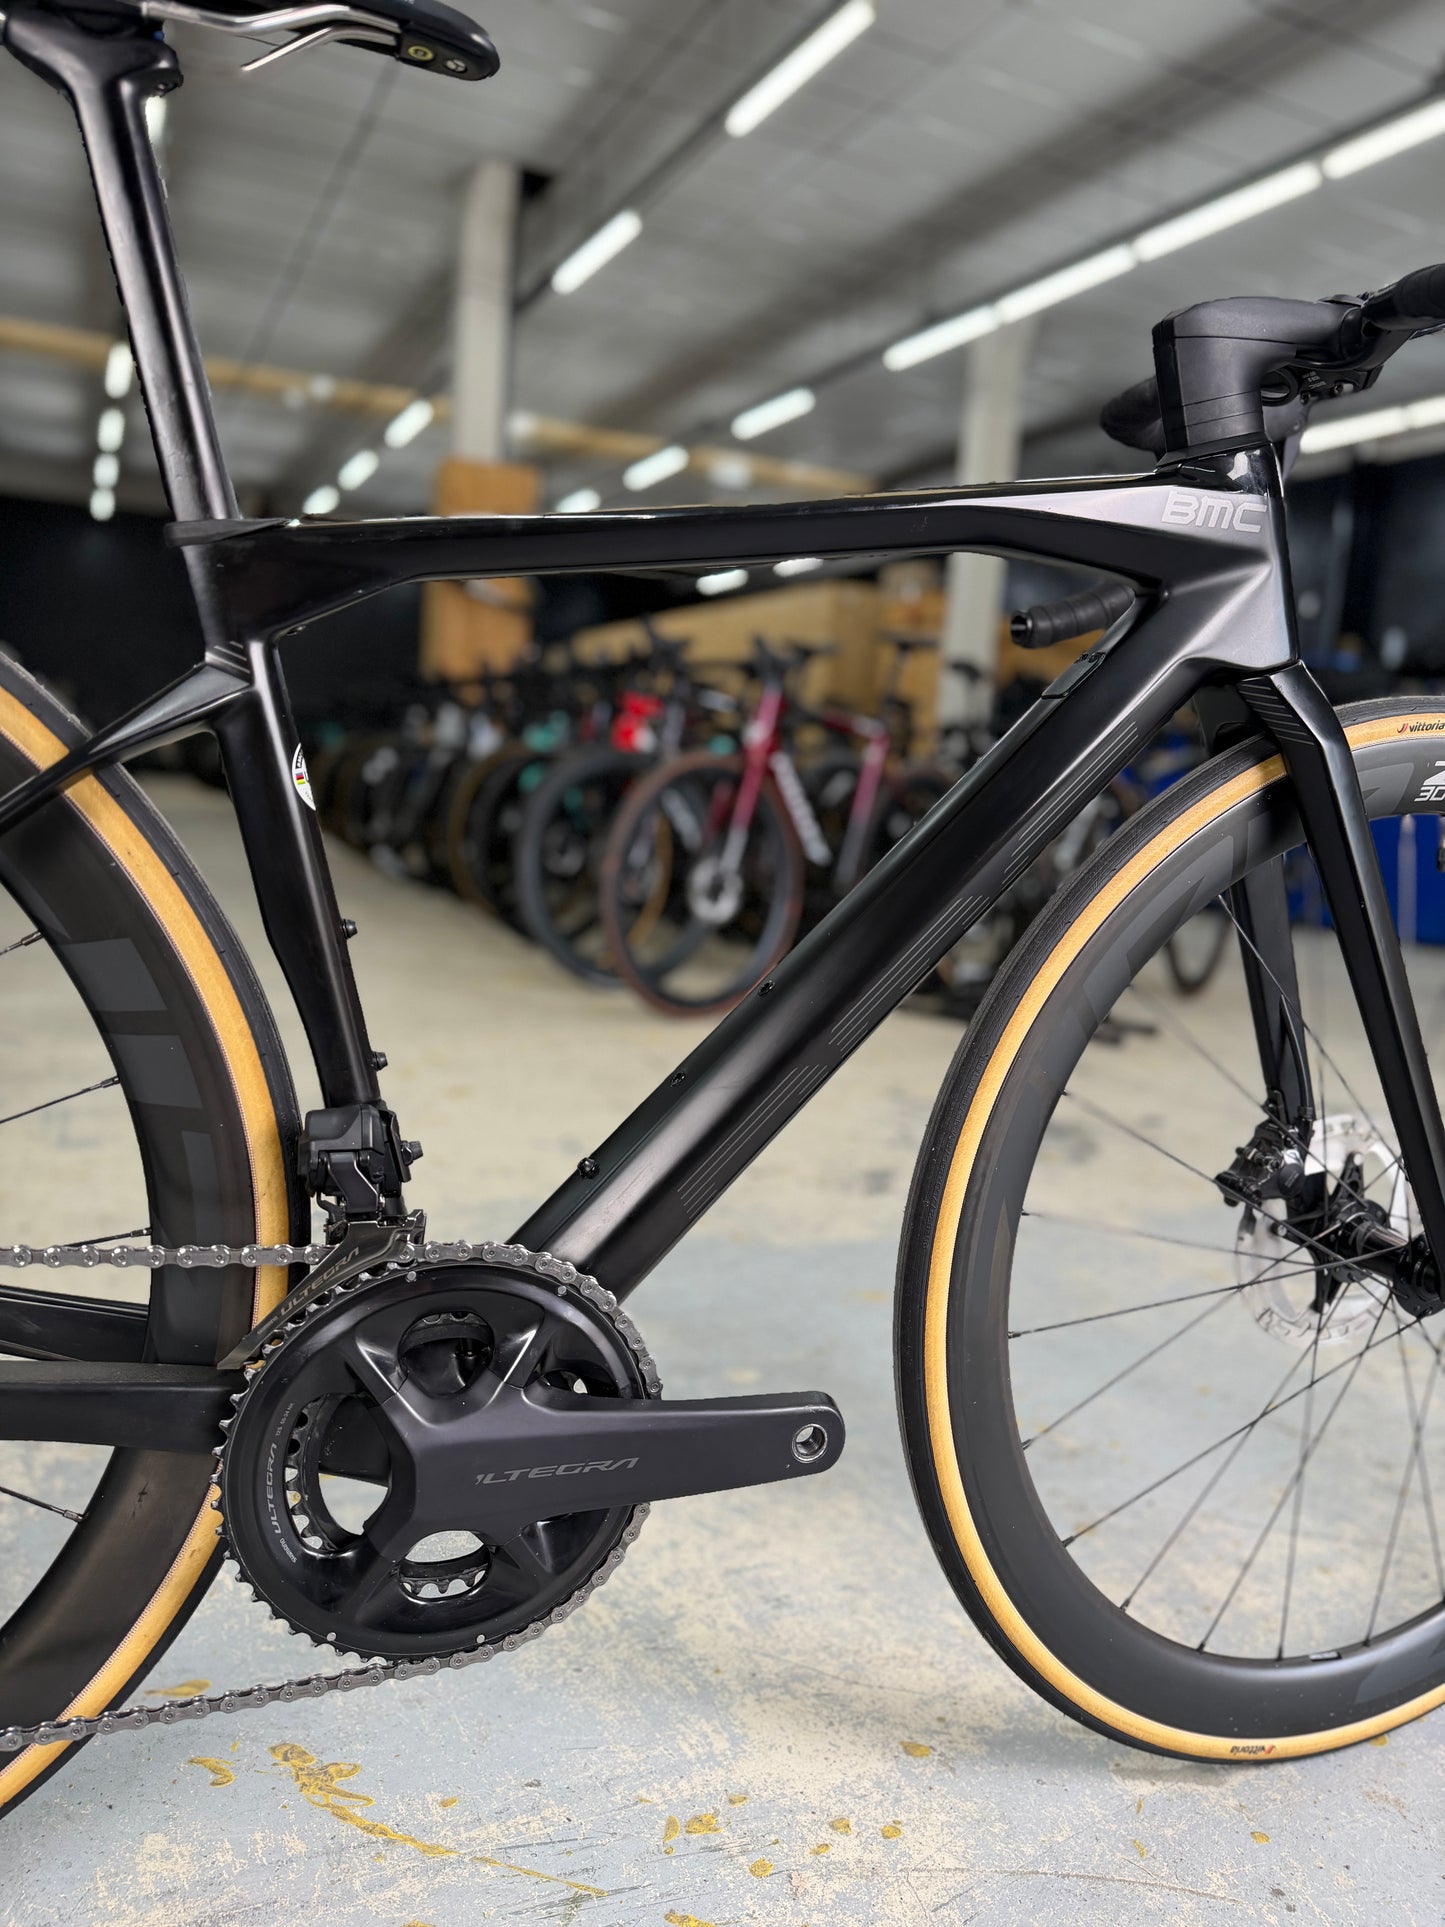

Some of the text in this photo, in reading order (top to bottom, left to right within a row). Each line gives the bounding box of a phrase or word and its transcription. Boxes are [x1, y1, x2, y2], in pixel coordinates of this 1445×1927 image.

[1161, 490, 1268, 533] BMC
[1409, 719, 1445, 733] vittoria
[280, 1246, 360, 1316] ULTEGRA
[266, 1442, 282, 1534] ULTEGRA
[1230, 1744, 1266, 1756] vittoria
